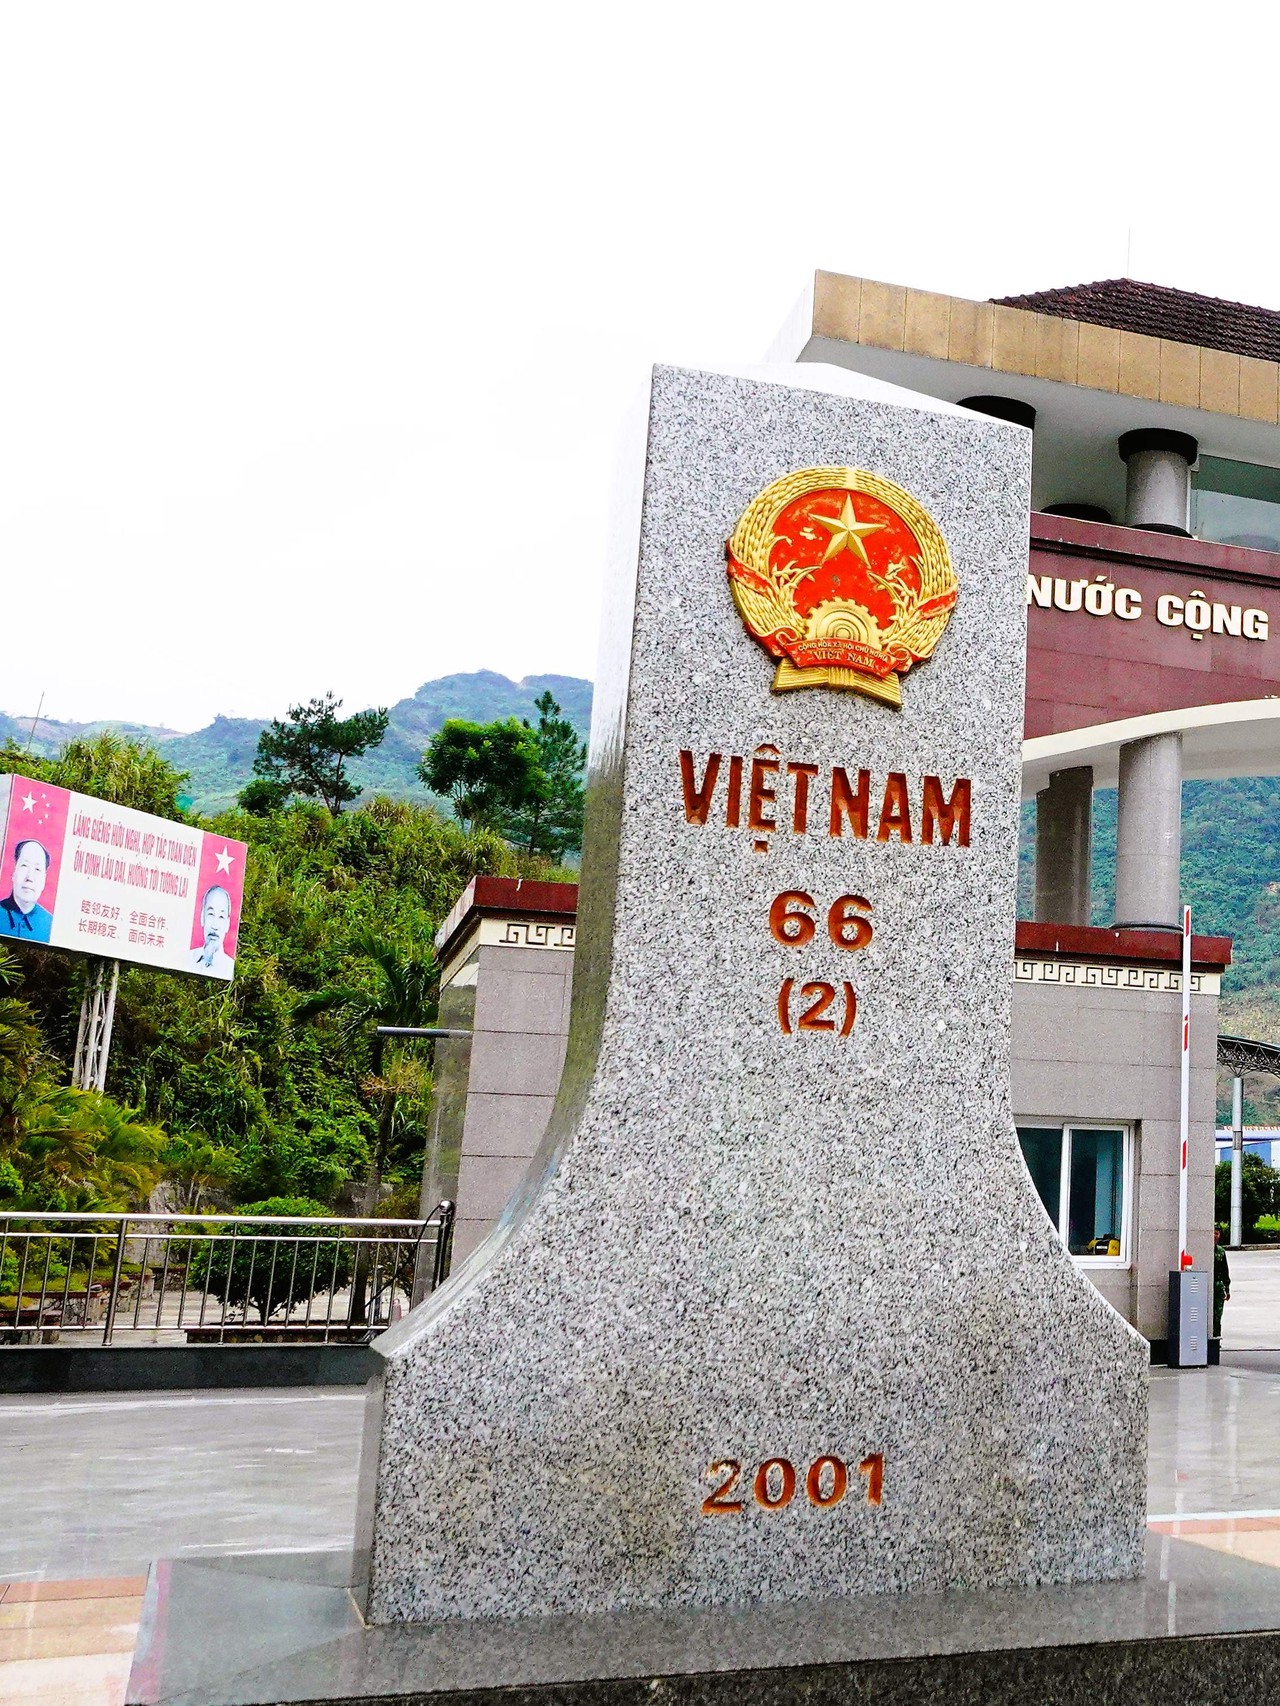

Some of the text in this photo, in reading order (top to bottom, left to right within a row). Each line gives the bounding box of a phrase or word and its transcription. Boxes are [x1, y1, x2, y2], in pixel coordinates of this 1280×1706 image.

[1026, 574, 1142, 620] NƯỚC
[1156, 590, 1269, 641] CỘNG
[769, 890, 874, 951] 66
[777, 978, 858, 1037] (2)
[700, 1453, 885, 1515] 2001
